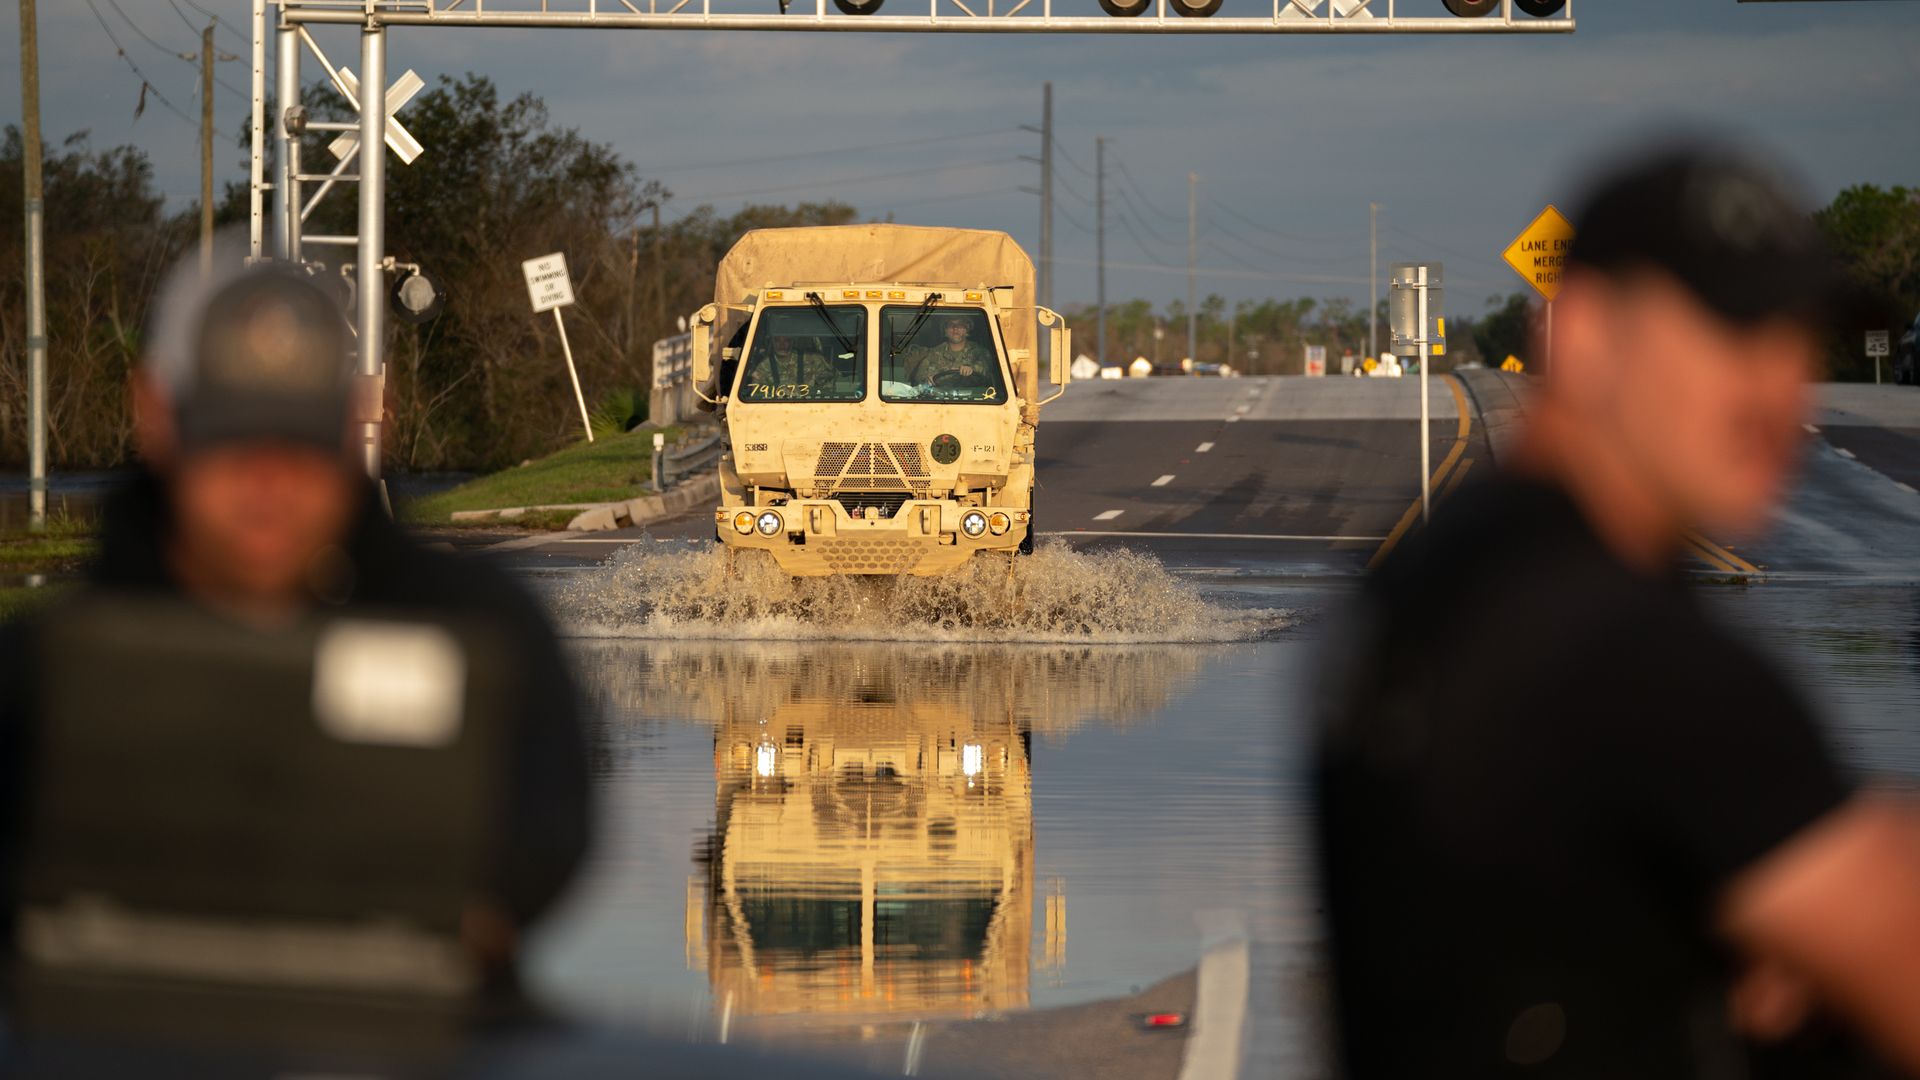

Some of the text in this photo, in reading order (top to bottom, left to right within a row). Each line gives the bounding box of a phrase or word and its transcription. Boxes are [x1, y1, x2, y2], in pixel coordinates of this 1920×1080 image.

[1521, 239, 1576, 252] LANE END
[537, 261, 551, 271] NO
[530, 269, 566, 284] SWIMMING
[1535, 272, 1560, 284] RIGH
[544, 282, 554, 292] OR
[540, 291, 564, 304] DIVING
[1868, 343, 1888, 352] 45
[747, 383, 810, 398] 791673
